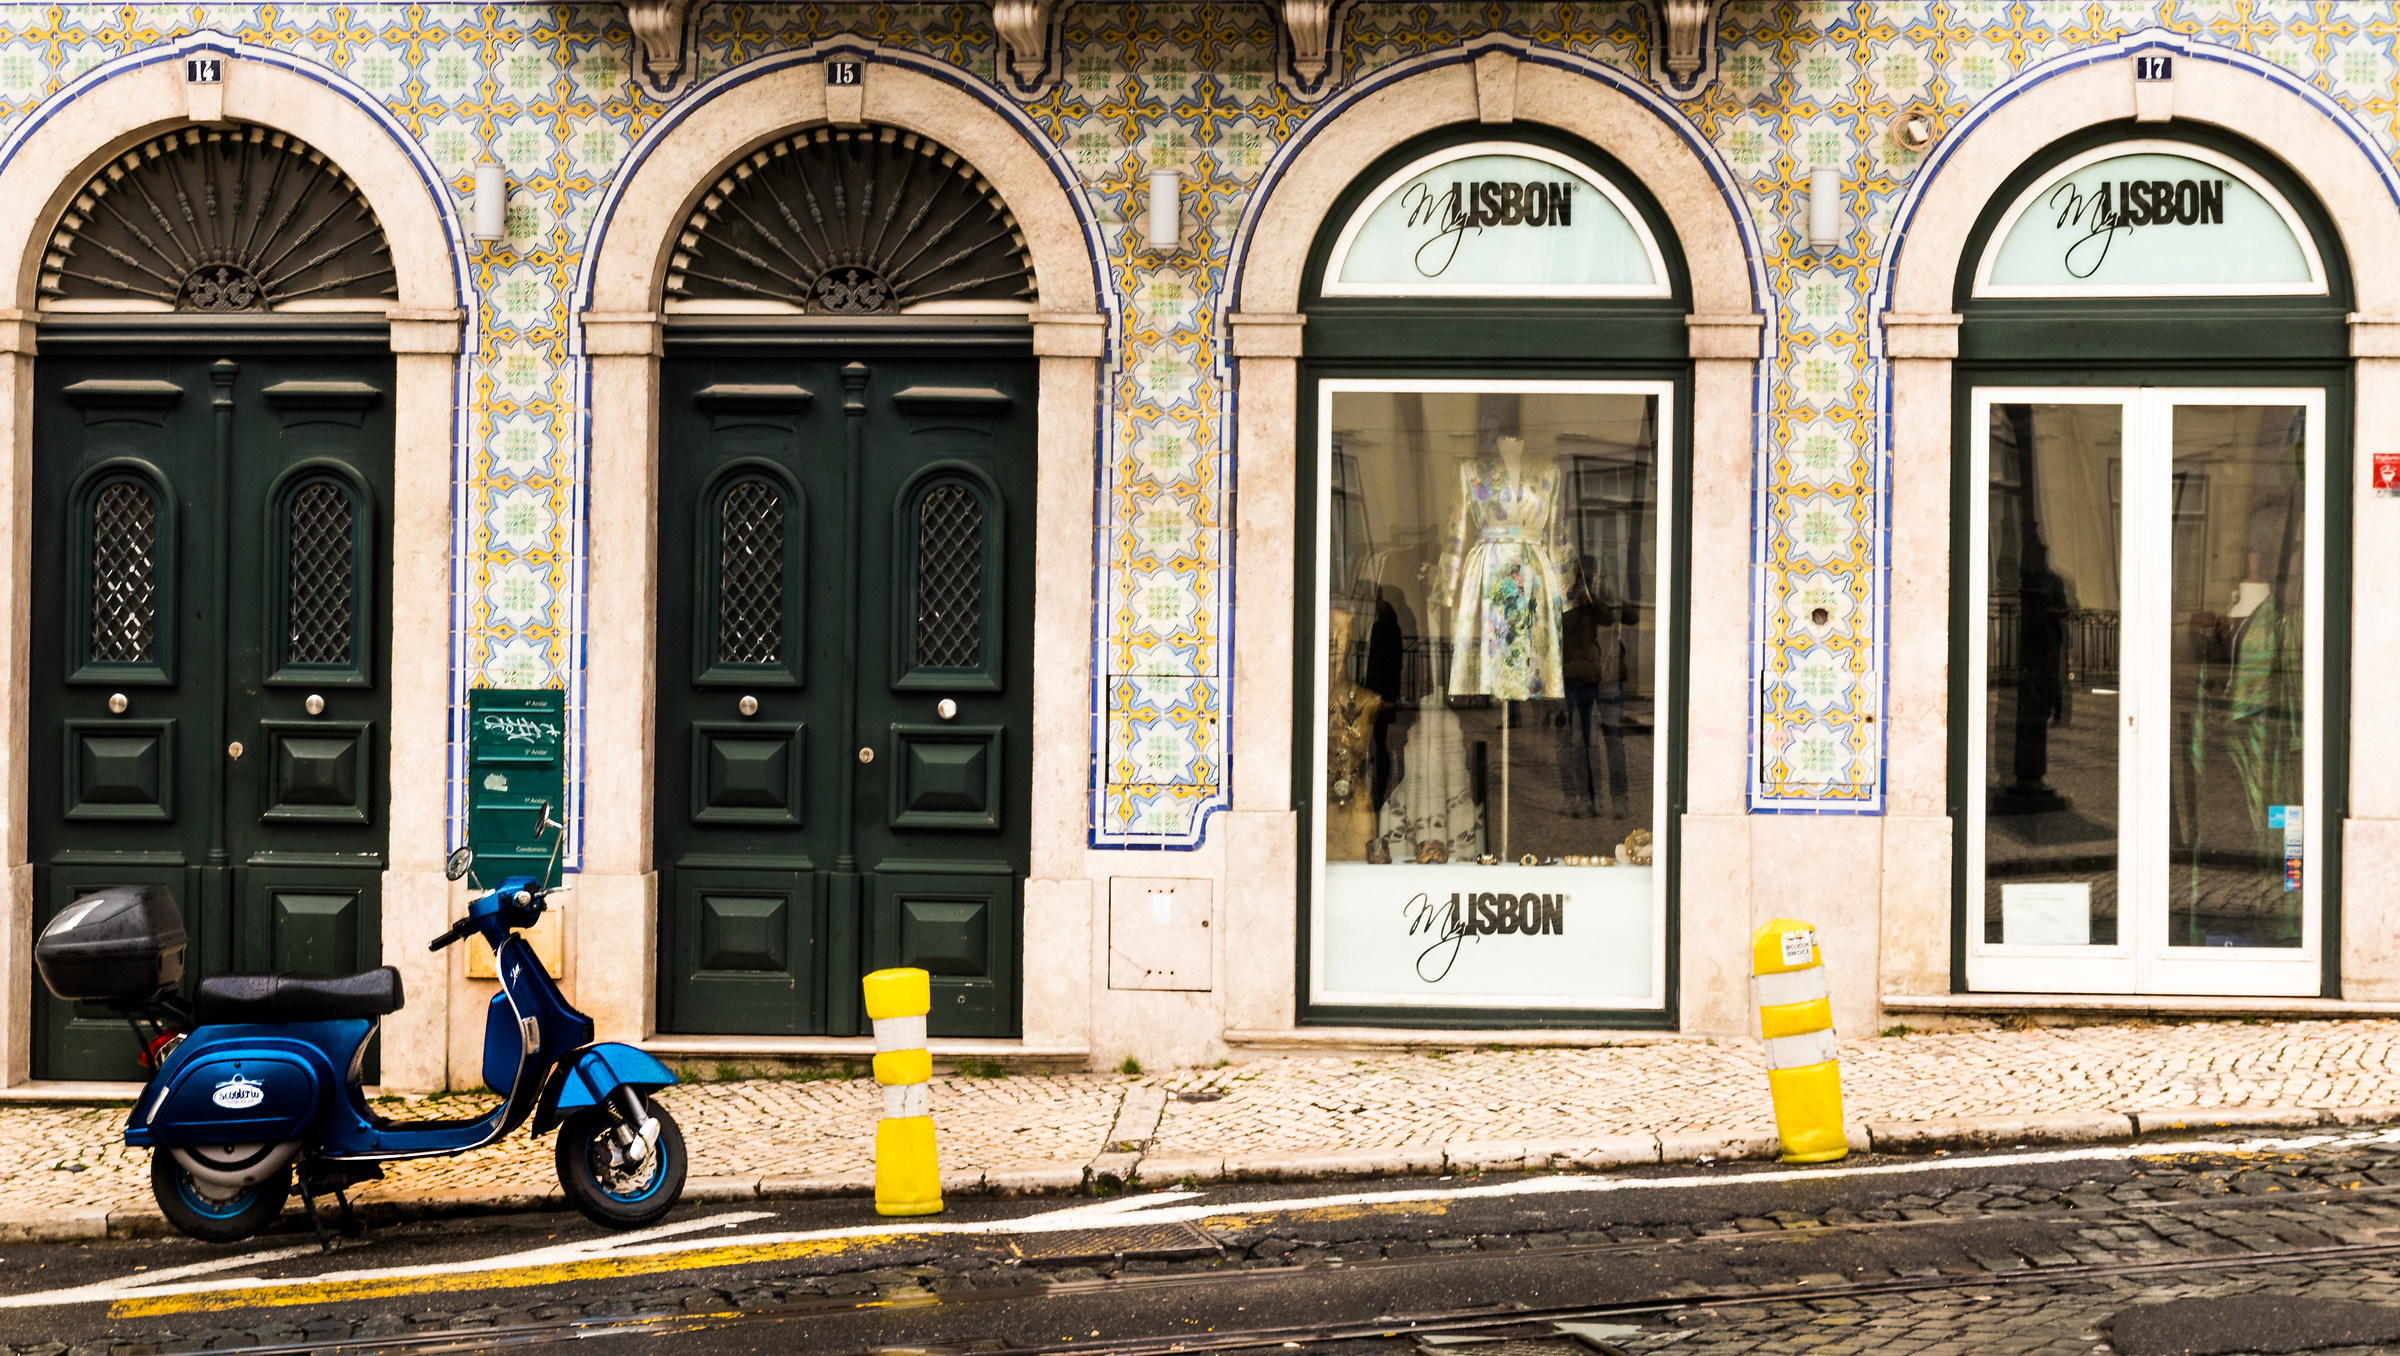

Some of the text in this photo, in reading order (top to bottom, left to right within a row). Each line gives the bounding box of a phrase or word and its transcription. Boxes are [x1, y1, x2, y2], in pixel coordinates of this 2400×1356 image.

[195, 60, 214, 82] 14
[835, 63, 854, 84] 15
[2145, 57, 2165, 79] 17
